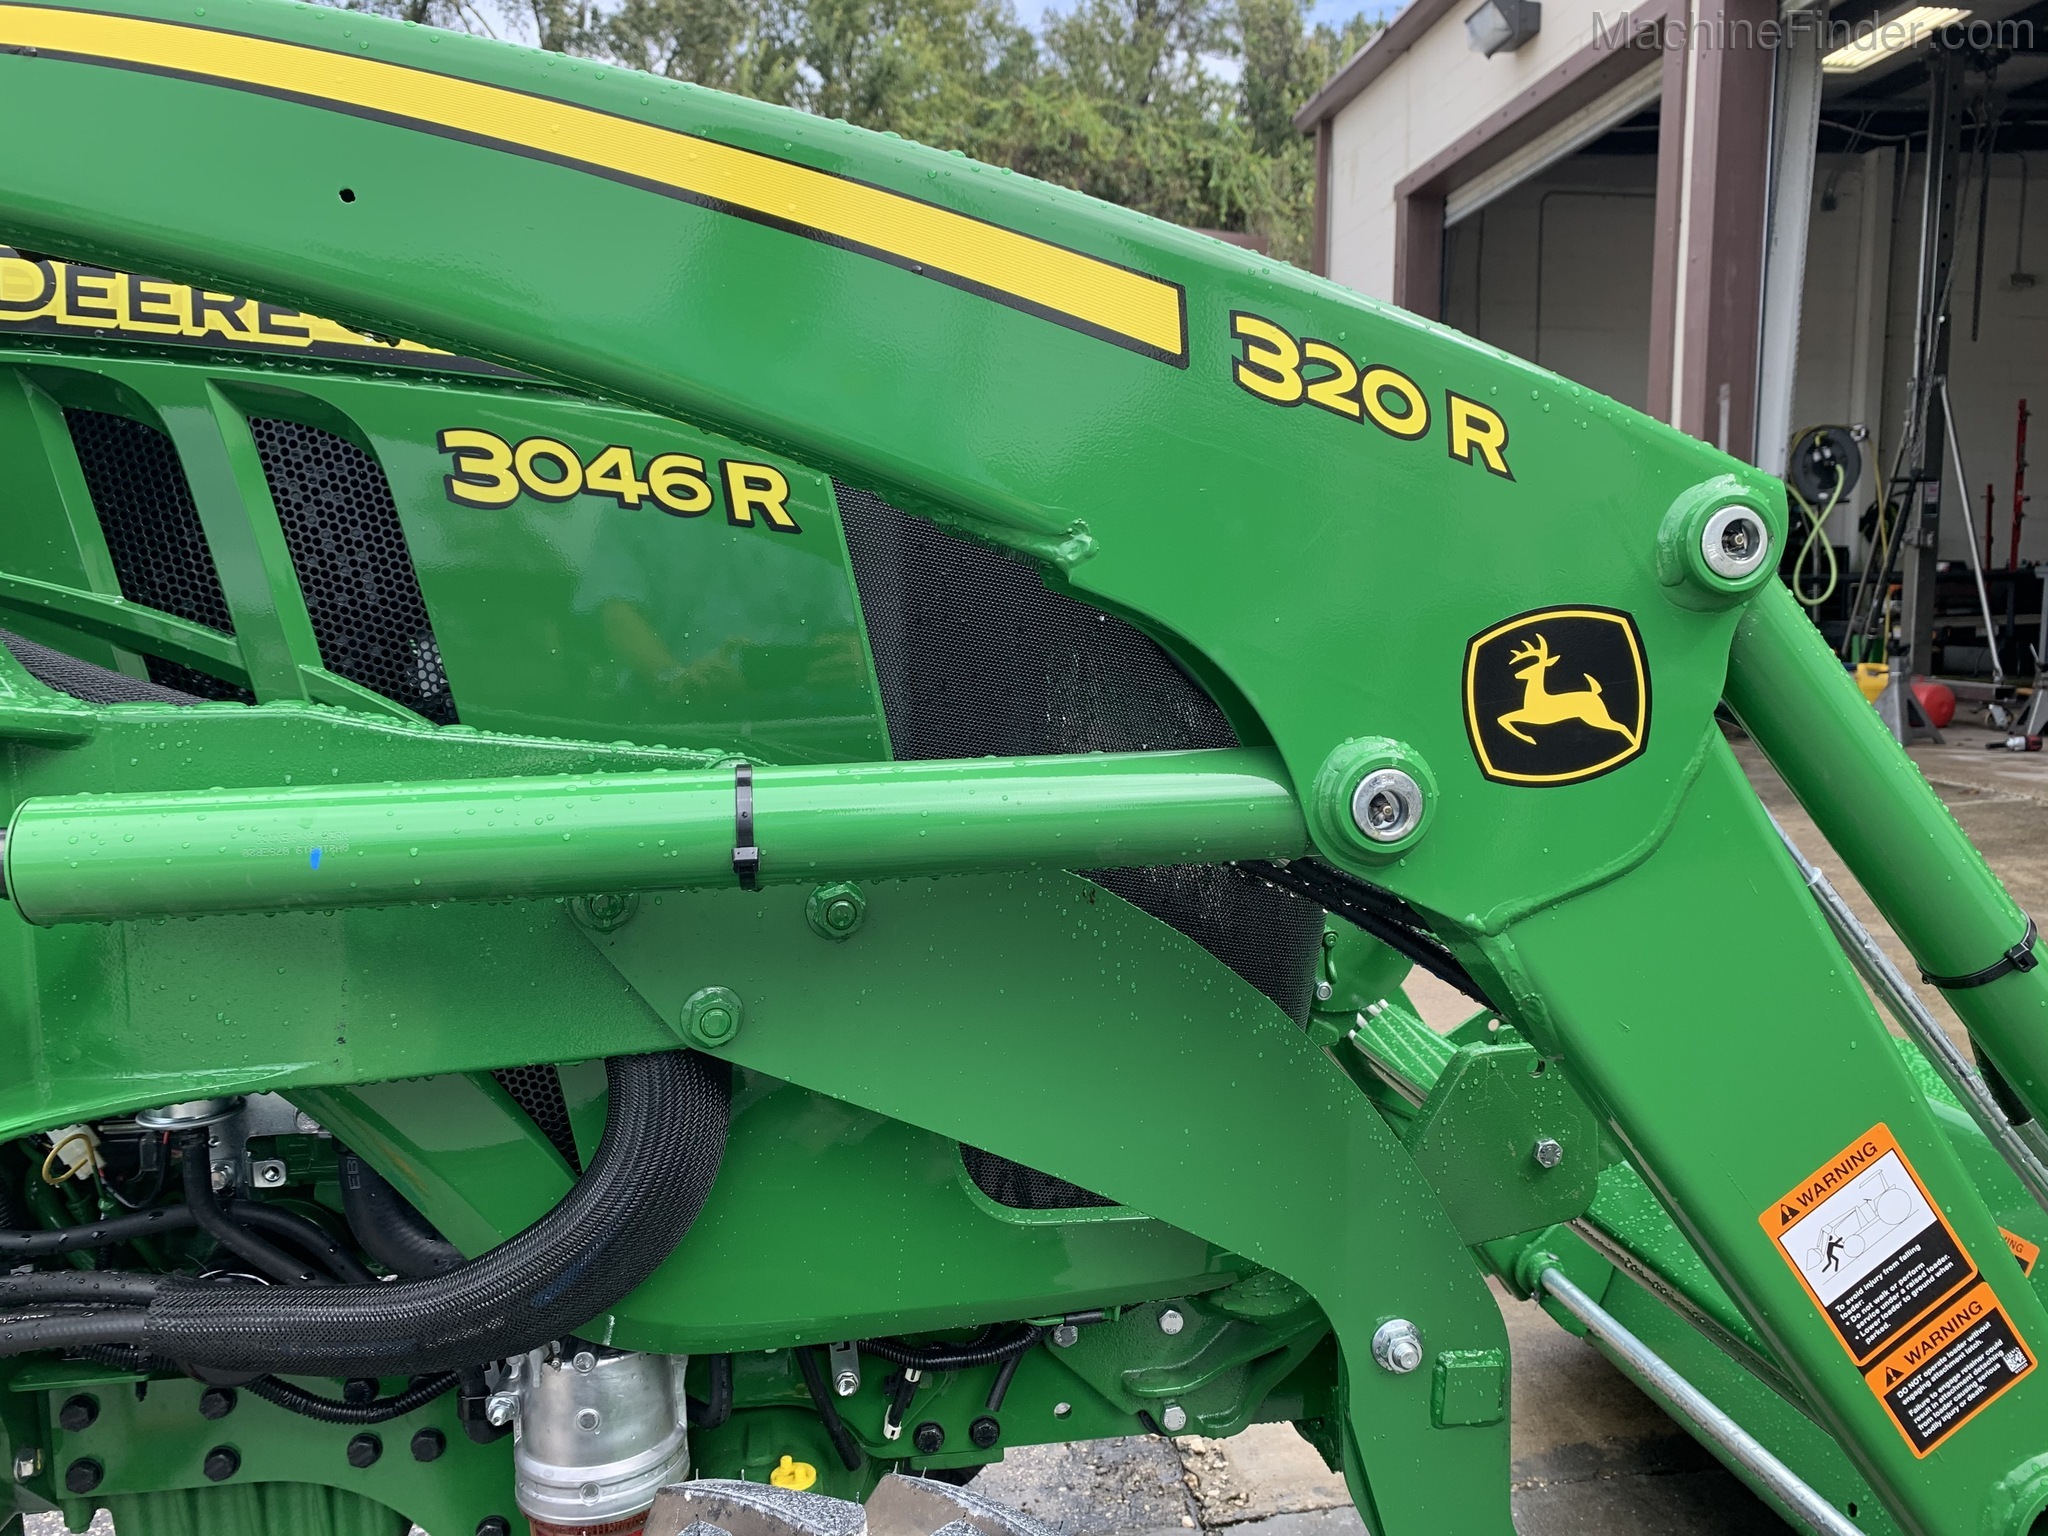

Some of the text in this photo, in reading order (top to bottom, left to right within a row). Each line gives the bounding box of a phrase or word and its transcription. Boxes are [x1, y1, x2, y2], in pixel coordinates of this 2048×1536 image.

[1231, 310, 1516, 482] 320 R
[437, 429, 803, 534] 3046 R
[1795, 1141, 1878, 1207] WARNING
[1834, 1243, 1922, 1312] To avoid injury from falling
[1839, 1298, 1865, 1320] loader:
[1849, 1261, 1926, 1323] Do not walk or perform
[1855, 1253, 1951, 1330] service under a raised loader.
[1858, 1261, 1954, 1337] Lower loader to ground when
[1864, 1321, 1892, 1345] parked.
[1896, 1320, 1992, 1399] DO NOT operate loader without
[1903, 1300, 1983, 1365] WARNING
[1901, 1339, 1984, 1406] engaging attachment latch.
[1907, 1338, 2004, 1417] Failure to engage retainer could
[1912, 1405, 1933, 1424] result
[1929, 1401, 1939, 1410] in
[1937, 1372, 1974, 1404] attachment
[1972, 1349, 2005, 1376] detaching
[1917, 1415, 1934, 1431] from
[1931, 1399, 1953, 1419] loader
[1952, 1380, 1979, 1402] causing
[1976, 1362, 2001, 1383] serious
[1921, 1384, 1988, 1438] bodily injury or death.
